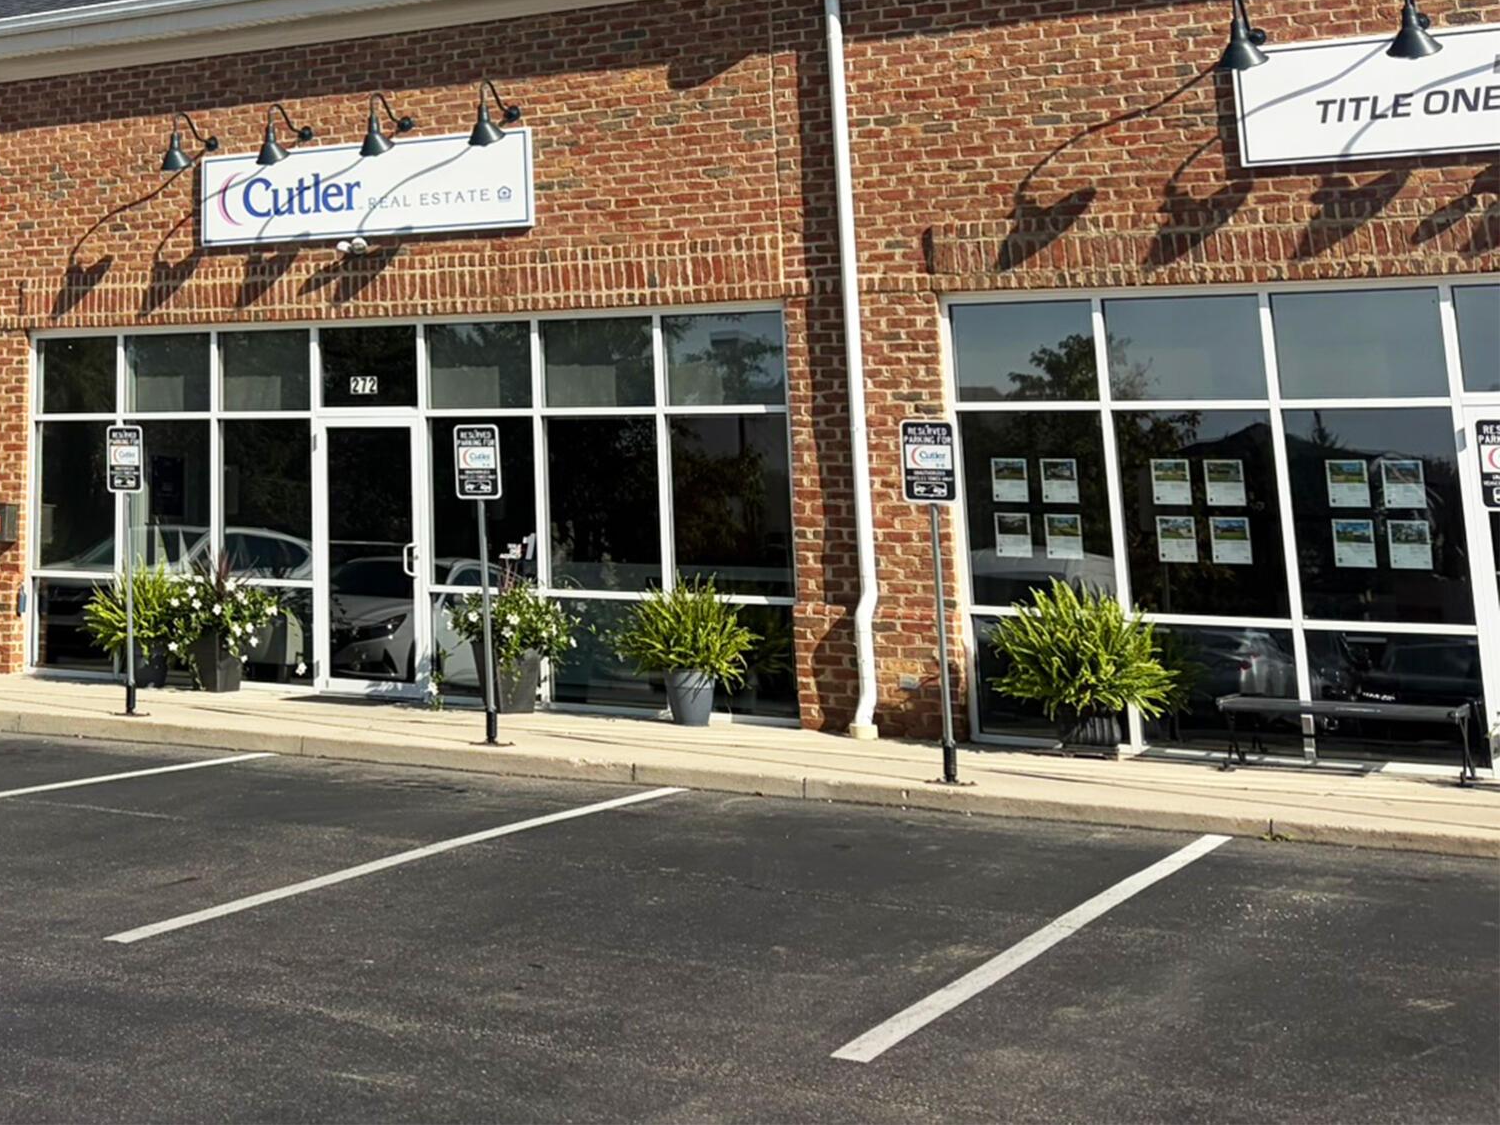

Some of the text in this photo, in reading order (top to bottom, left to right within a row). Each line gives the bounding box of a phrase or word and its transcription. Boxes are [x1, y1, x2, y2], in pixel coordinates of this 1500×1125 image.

[1316, 85, 1500, 124] TITLE ONE
[243, 173, 491, 218] Cutler REAL ESTATE
[351, 376, 377, 393] 272
[907, 427, 948, 435] RESERVED
[904, 436, 952, 444] PARKING FOR
[919, 450, 946, 459] Cutler
